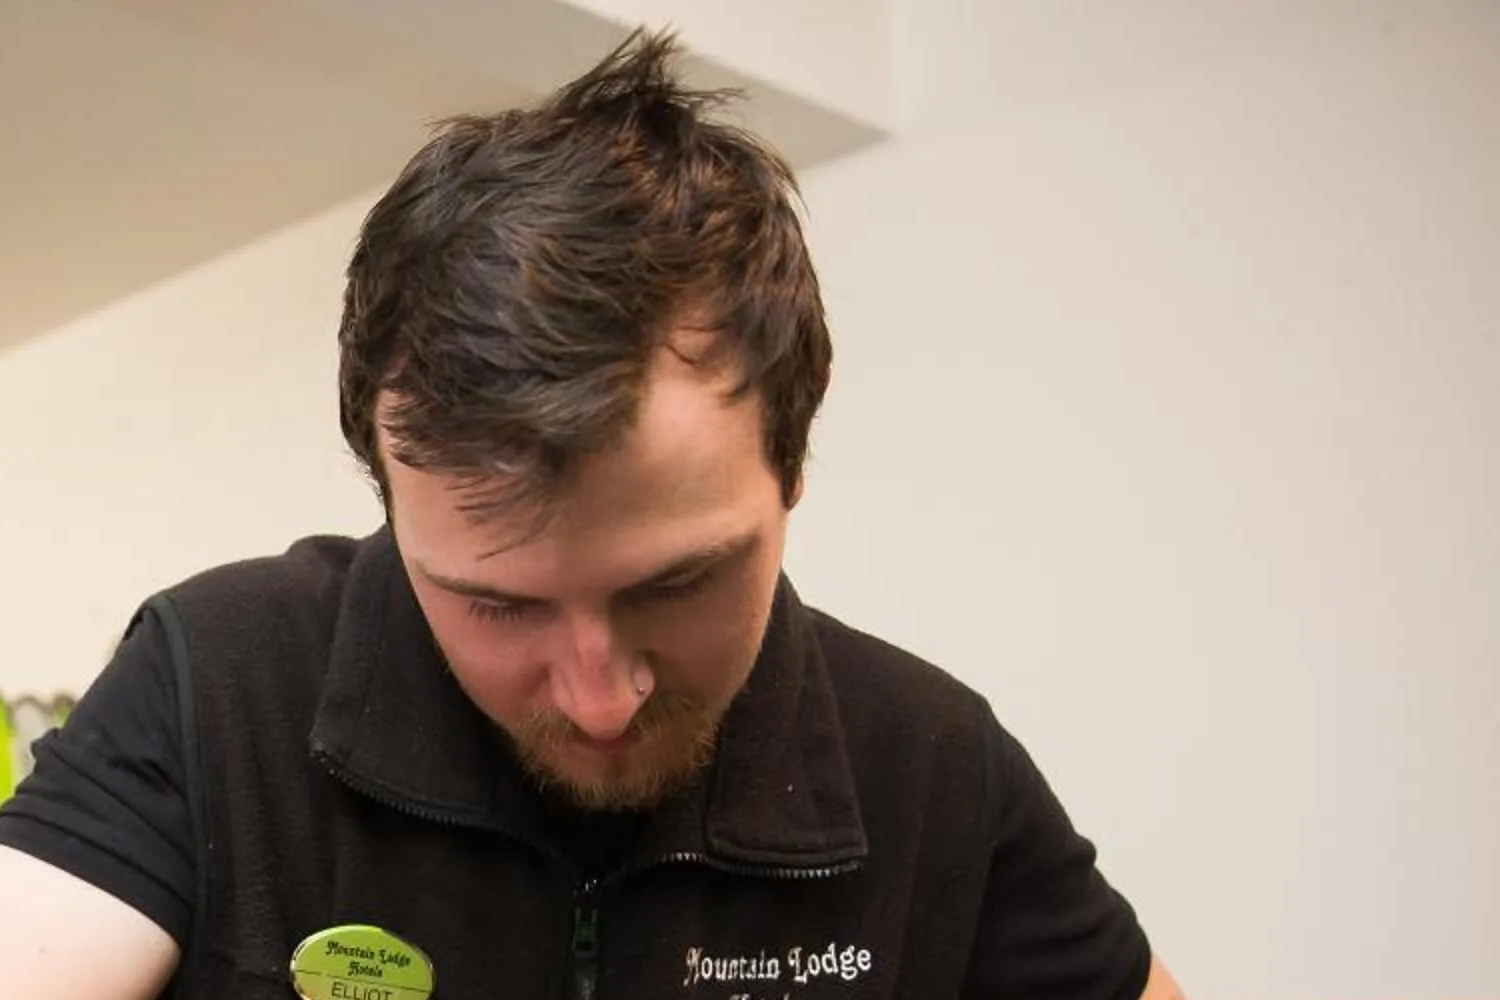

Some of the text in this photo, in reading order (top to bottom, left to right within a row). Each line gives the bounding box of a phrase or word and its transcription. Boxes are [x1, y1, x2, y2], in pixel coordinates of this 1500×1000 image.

[325, 941, 411, 969] Mountain Lodge
[683, 943, 872, 987] Mountain Lodge
[347, 961, 384, 978] Hotels
